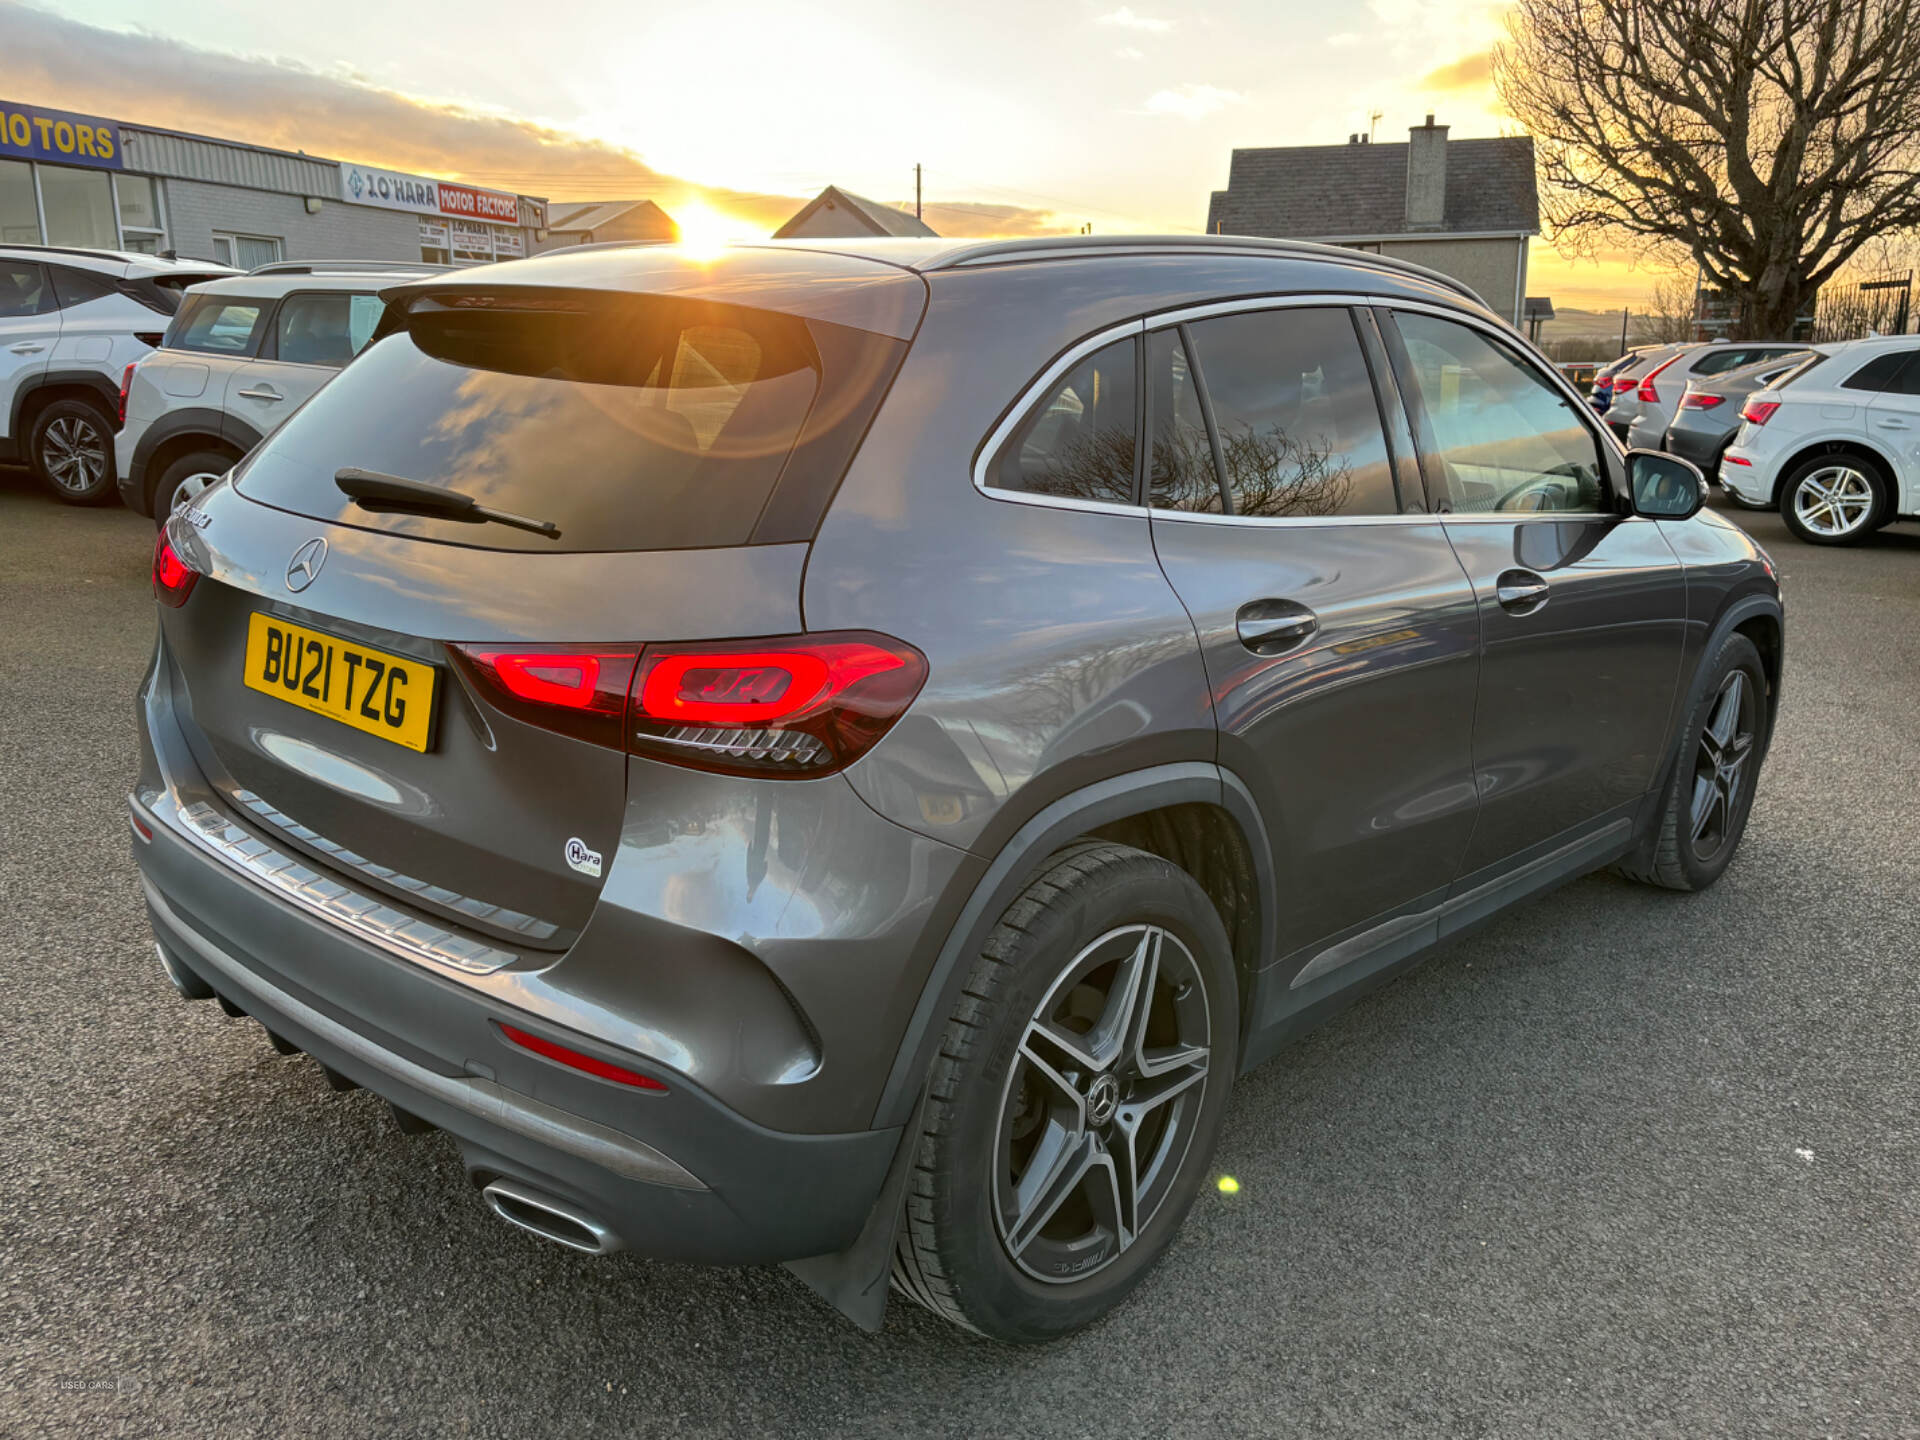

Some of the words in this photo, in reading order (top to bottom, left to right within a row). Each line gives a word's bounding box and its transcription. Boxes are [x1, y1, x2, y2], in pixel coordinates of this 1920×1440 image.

[440, 188, 474, 212] MOTOR
[476, 194, 516, 218] FACTORS
[263, 626, 333, 702] BU21
[343, 651, 408, 728] TZG
